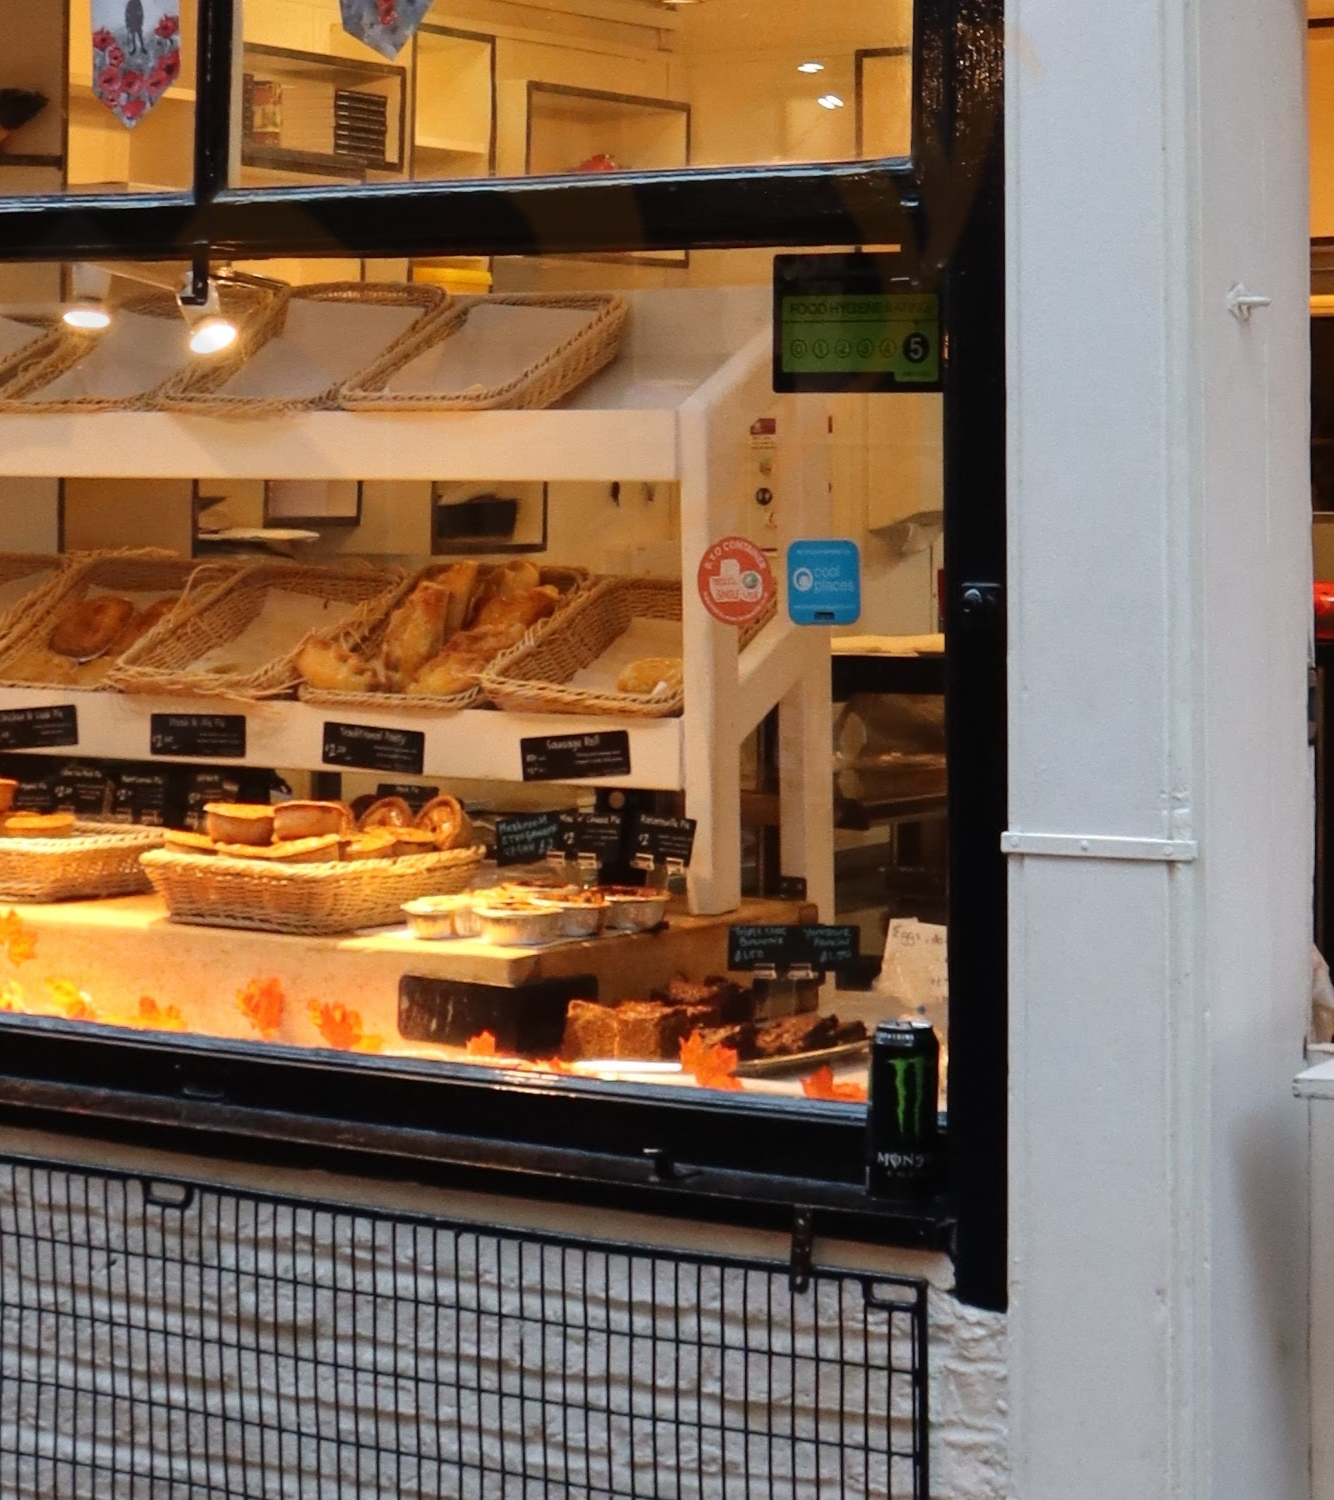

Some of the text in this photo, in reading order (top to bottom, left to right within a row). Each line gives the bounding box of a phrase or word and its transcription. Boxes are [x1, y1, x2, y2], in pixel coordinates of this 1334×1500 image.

[909, 337, 924, 360] 5
[813, 579, 855, 595] places
[547, 740, 582, 752] Sausage
